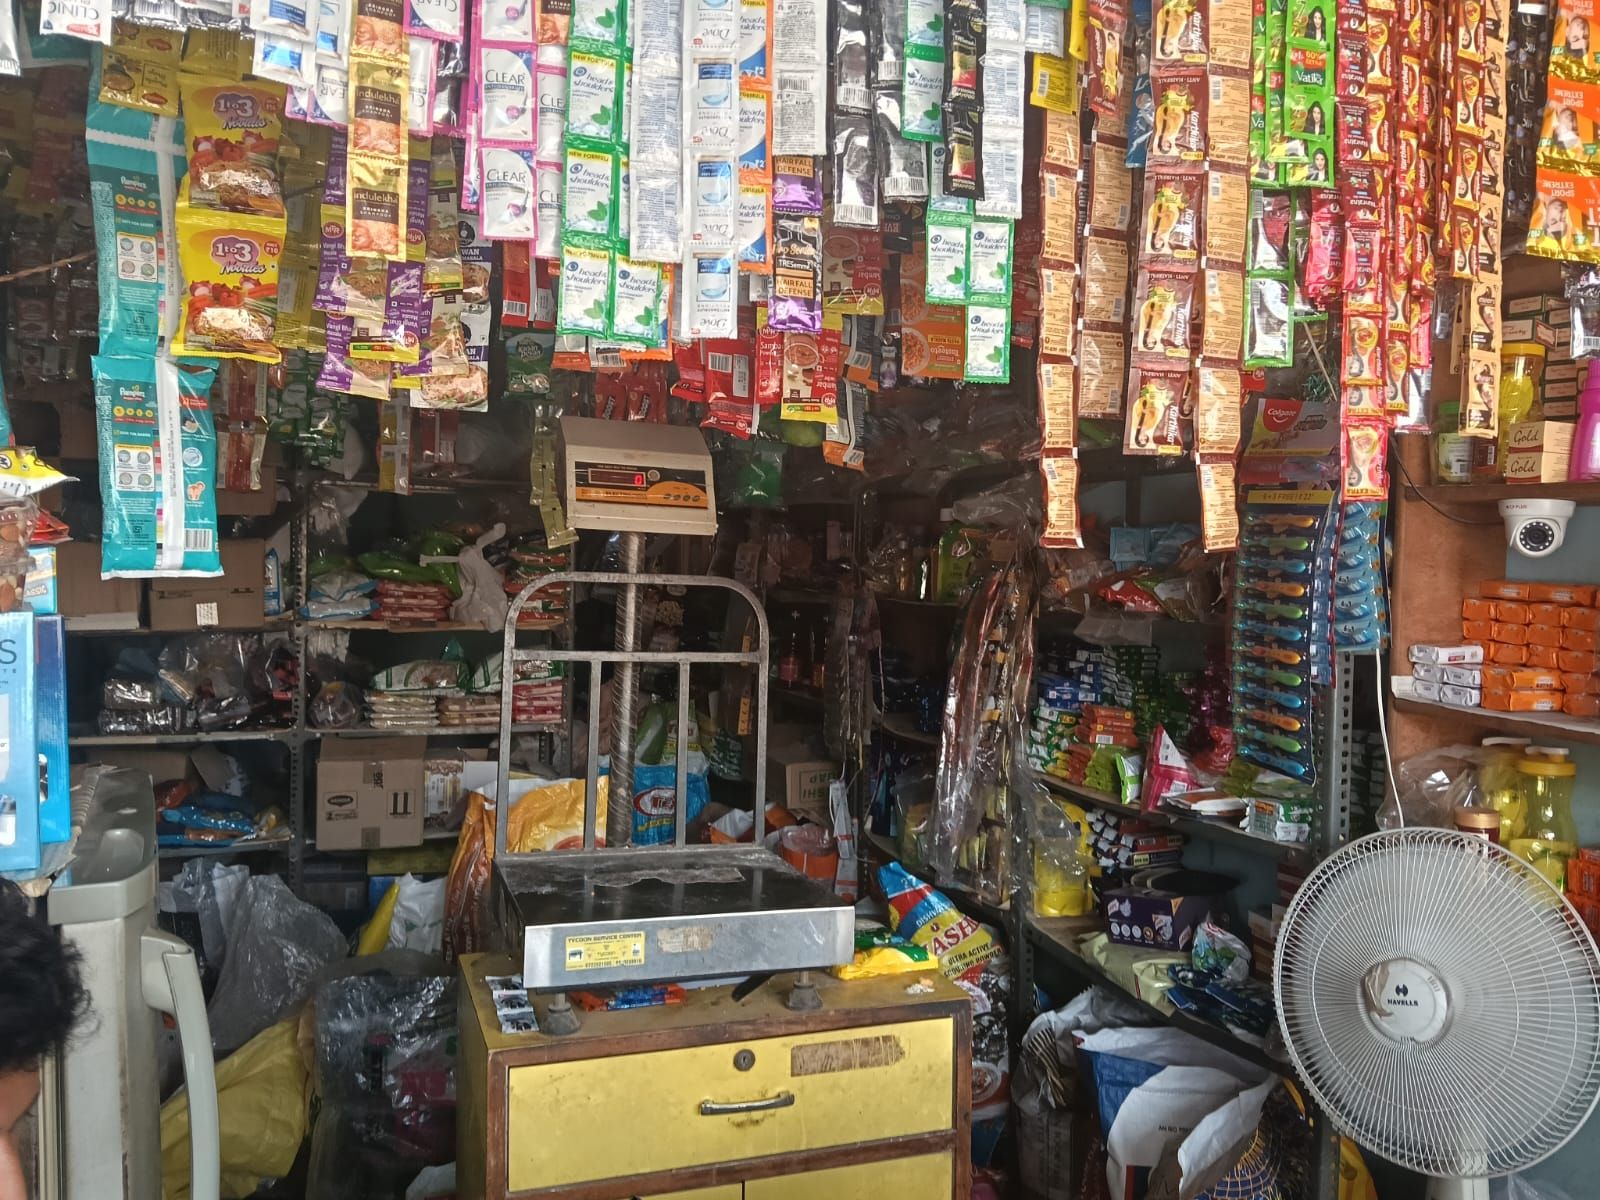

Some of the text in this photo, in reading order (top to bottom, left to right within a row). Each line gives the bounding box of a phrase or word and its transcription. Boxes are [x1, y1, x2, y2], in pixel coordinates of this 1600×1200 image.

[485, 69, 526, 84] CLEAR
[1295, 70, 1325, 86] Vatika
[540, 93, 565, 108] CLE
[1189, 110, 1201, 152] Karthika
[486, 168, 527, 184] CLEAR
[777, 165, 812, 176] DEFENSE
[353, 190, 398, 204] indulekha
[539, 191, 562, 204] CLE
[565, 275, 608, 287] shoulders
[778, 287, 812, 298] DEFENSE
[700, 318, 728, 329] Dove
[1267, 408, 1297, 417] Colgate
[1167, 404, 1179, 444] Karthika
[1513, 430, 1539, 445] Gold
[1510, 460, 1536, 474] Gold
[634, 474, 643, 485] 0
[924, 915, 980, 957] ASH
[968, 943, 990, 958] ACTIVE
[1387, 998, 1419, 1007] HAVELLS
